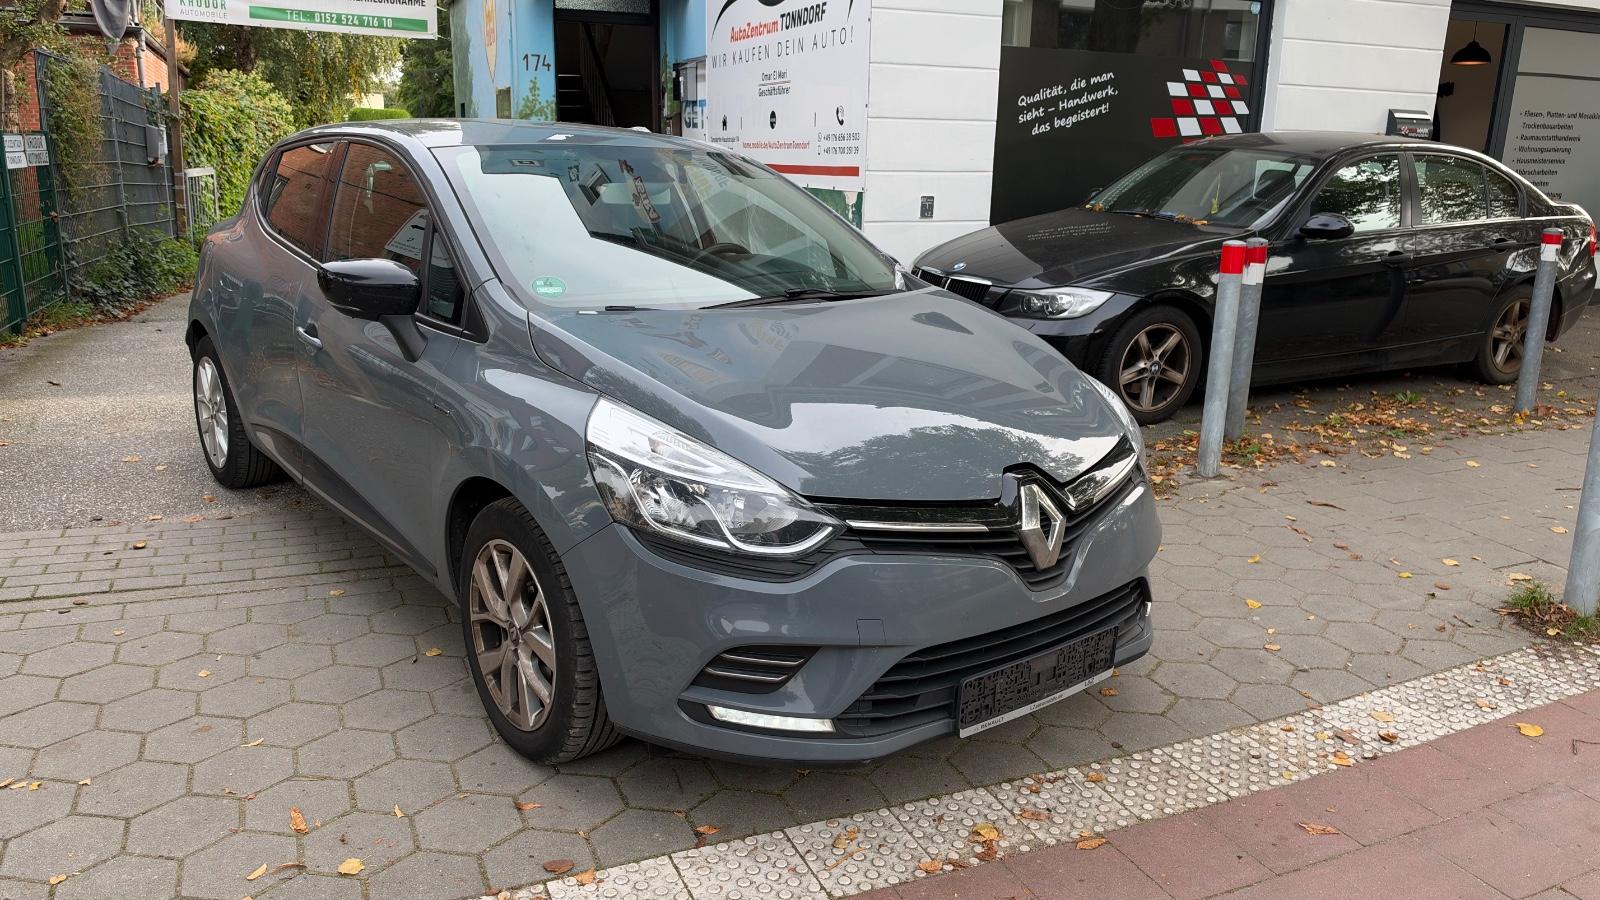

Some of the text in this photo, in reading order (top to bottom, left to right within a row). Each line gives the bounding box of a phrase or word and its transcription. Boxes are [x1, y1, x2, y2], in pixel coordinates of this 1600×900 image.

[180, 8, 228, 19] AUTOMOBILE
[285, 10, 393, 28] TEL: 0152 524 716 10
[730, 2, 827, 43] AutoZentrum TONNDORF
[711, 26, 854, 68] WIR KAUFEN DEIN AUTO!
[523, 53, 551, 72] 174
[762, 72, 773, 82] Omar
[1018, 72, 1114, 106] Qualität, die man
[758, 86, 791, 97] Geschäftsführer
[1018, 106, 1045, 123] sieht
[1059, 84, 1119, 111] Handwerk,
[1031, 102, 1109, 135] das begeistert!
